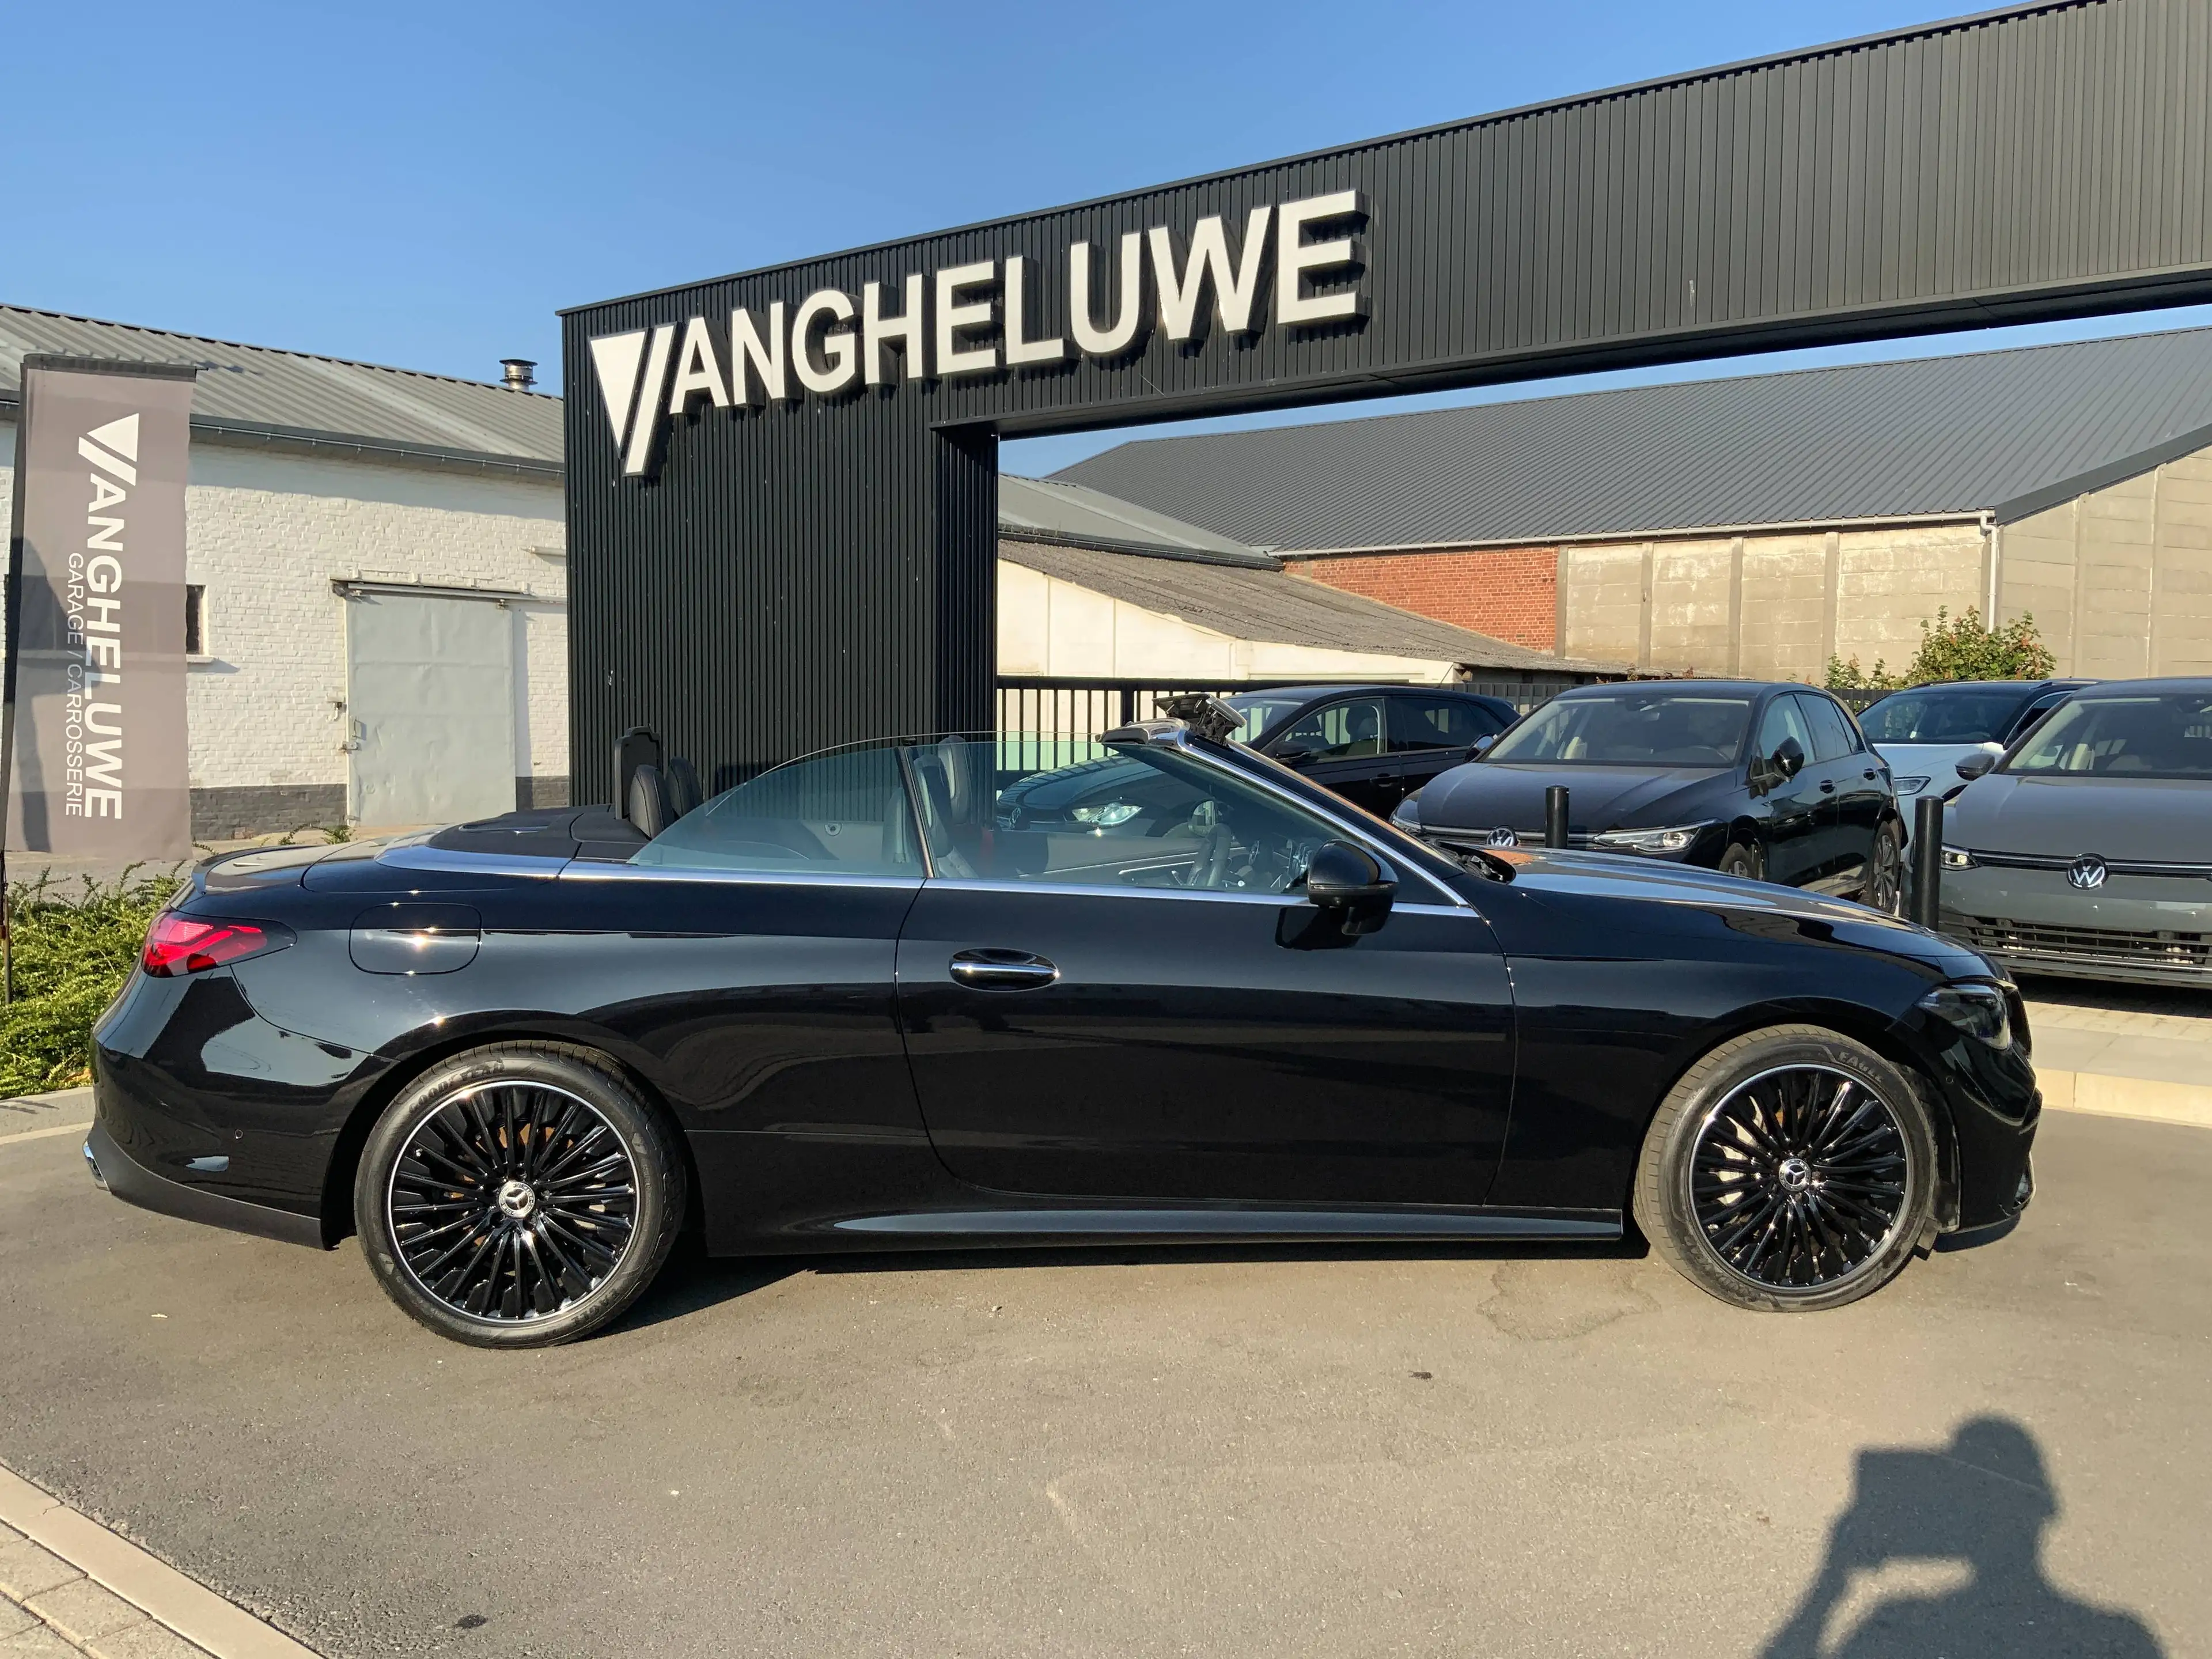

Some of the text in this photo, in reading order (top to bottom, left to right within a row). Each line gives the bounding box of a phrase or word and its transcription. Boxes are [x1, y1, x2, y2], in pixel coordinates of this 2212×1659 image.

[589, 190, 1357, 475] VANGHELUWE
[67, 552, 84, 645] GARAGE
[78, 413, 139, 819] VANGHELUWE
[65, 664, 82, 816] CARROSSERIE
